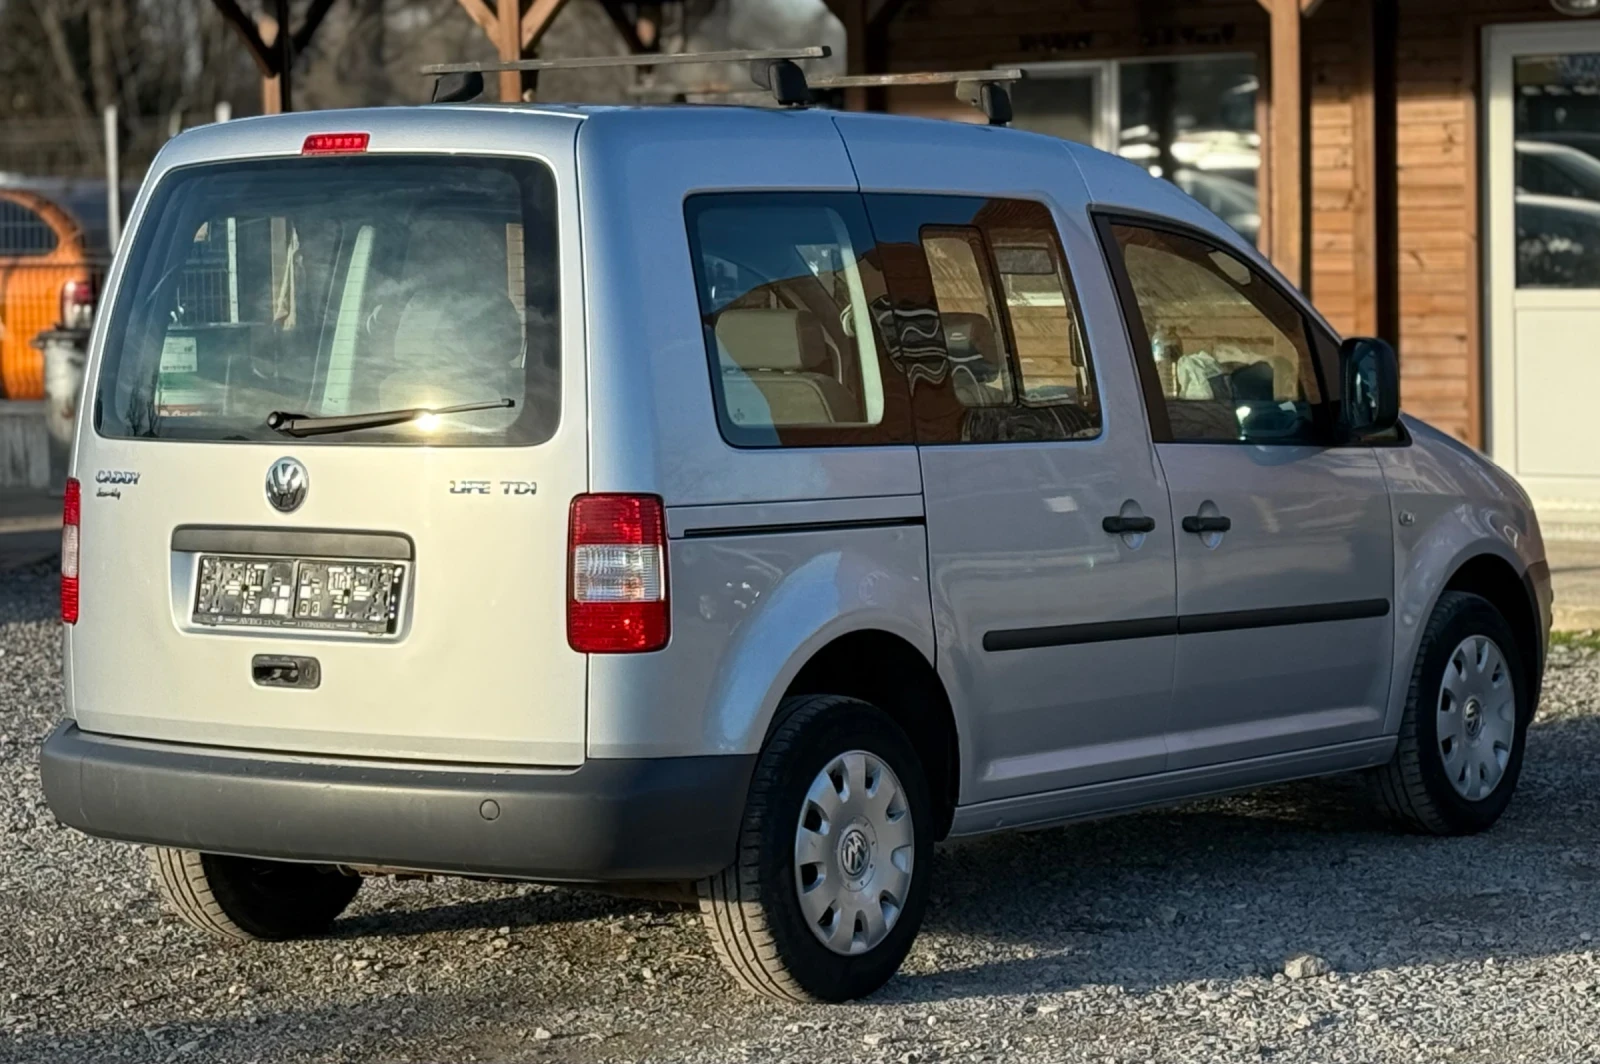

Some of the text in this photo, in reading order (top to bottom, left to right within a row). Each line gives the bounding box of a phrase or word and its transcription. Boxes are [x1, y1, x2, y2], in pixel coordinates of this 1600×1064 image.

[95, 469, 141, 485] CADDY
[449, 480, 537, 495] LIFE TDI
